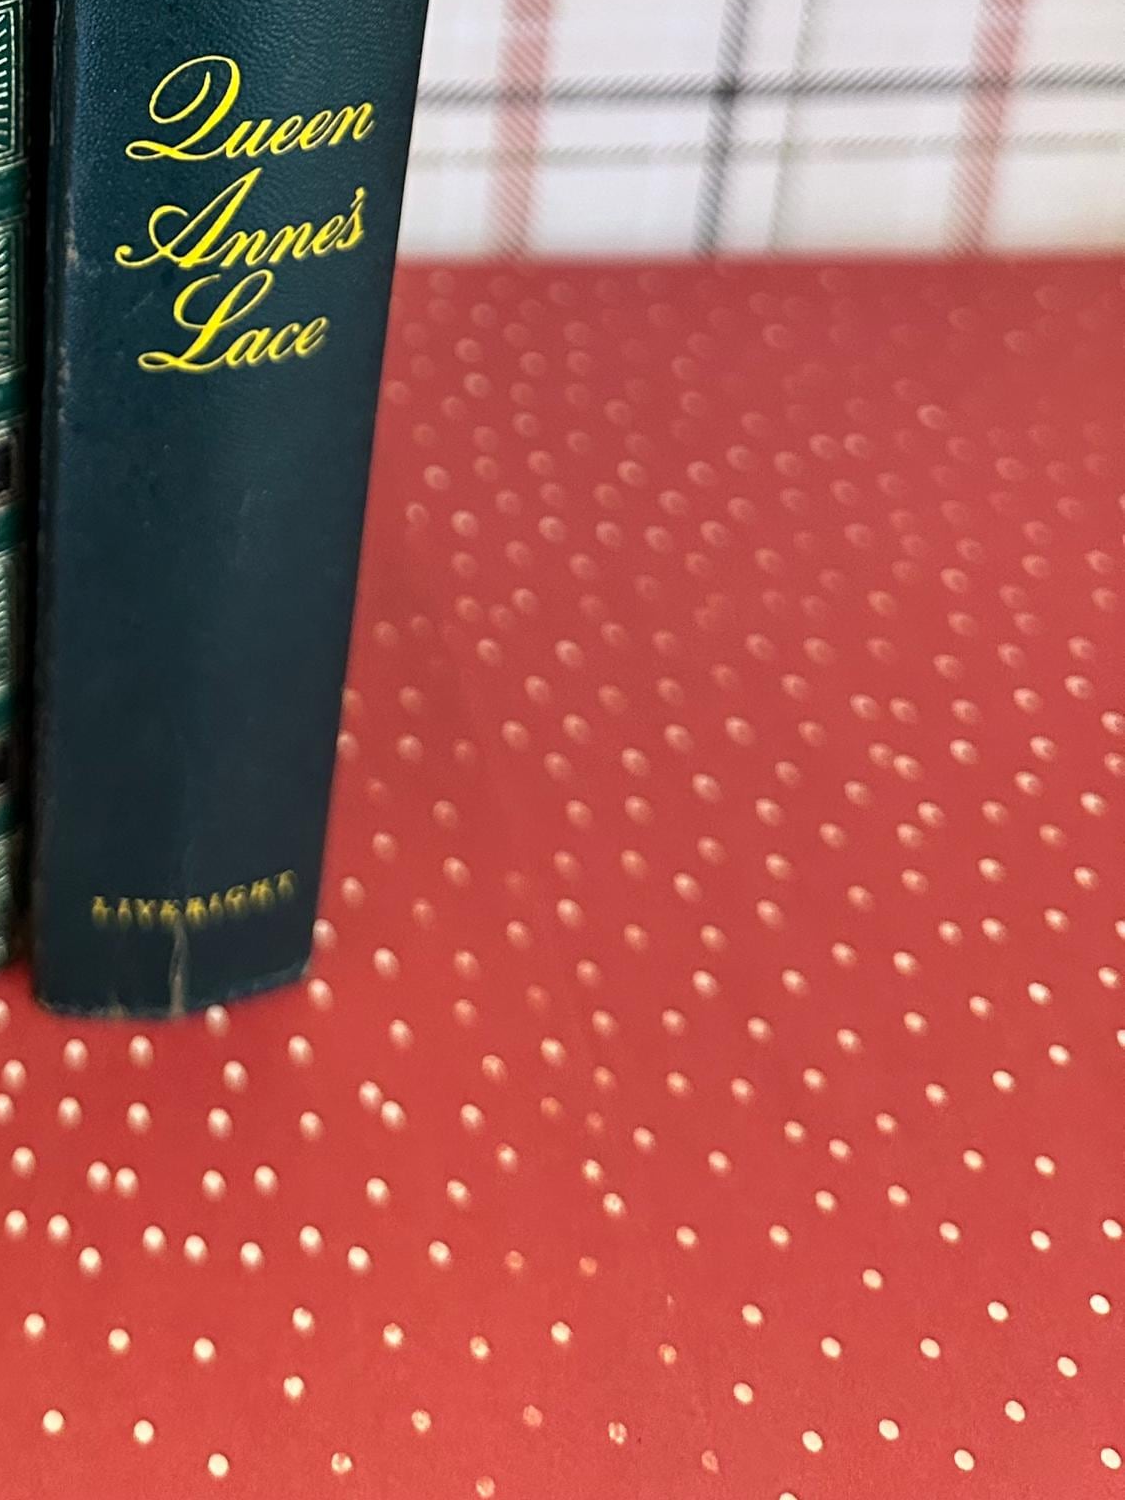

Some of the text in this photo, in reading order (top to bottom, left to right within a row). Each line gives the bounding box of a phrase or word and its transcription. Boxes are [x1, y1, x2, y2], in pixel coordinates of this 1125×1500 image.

[124, 55, 375, 162] Queen
[114, 166, 367, 270] Anne's
[137, 268, 331, 373] Lace
